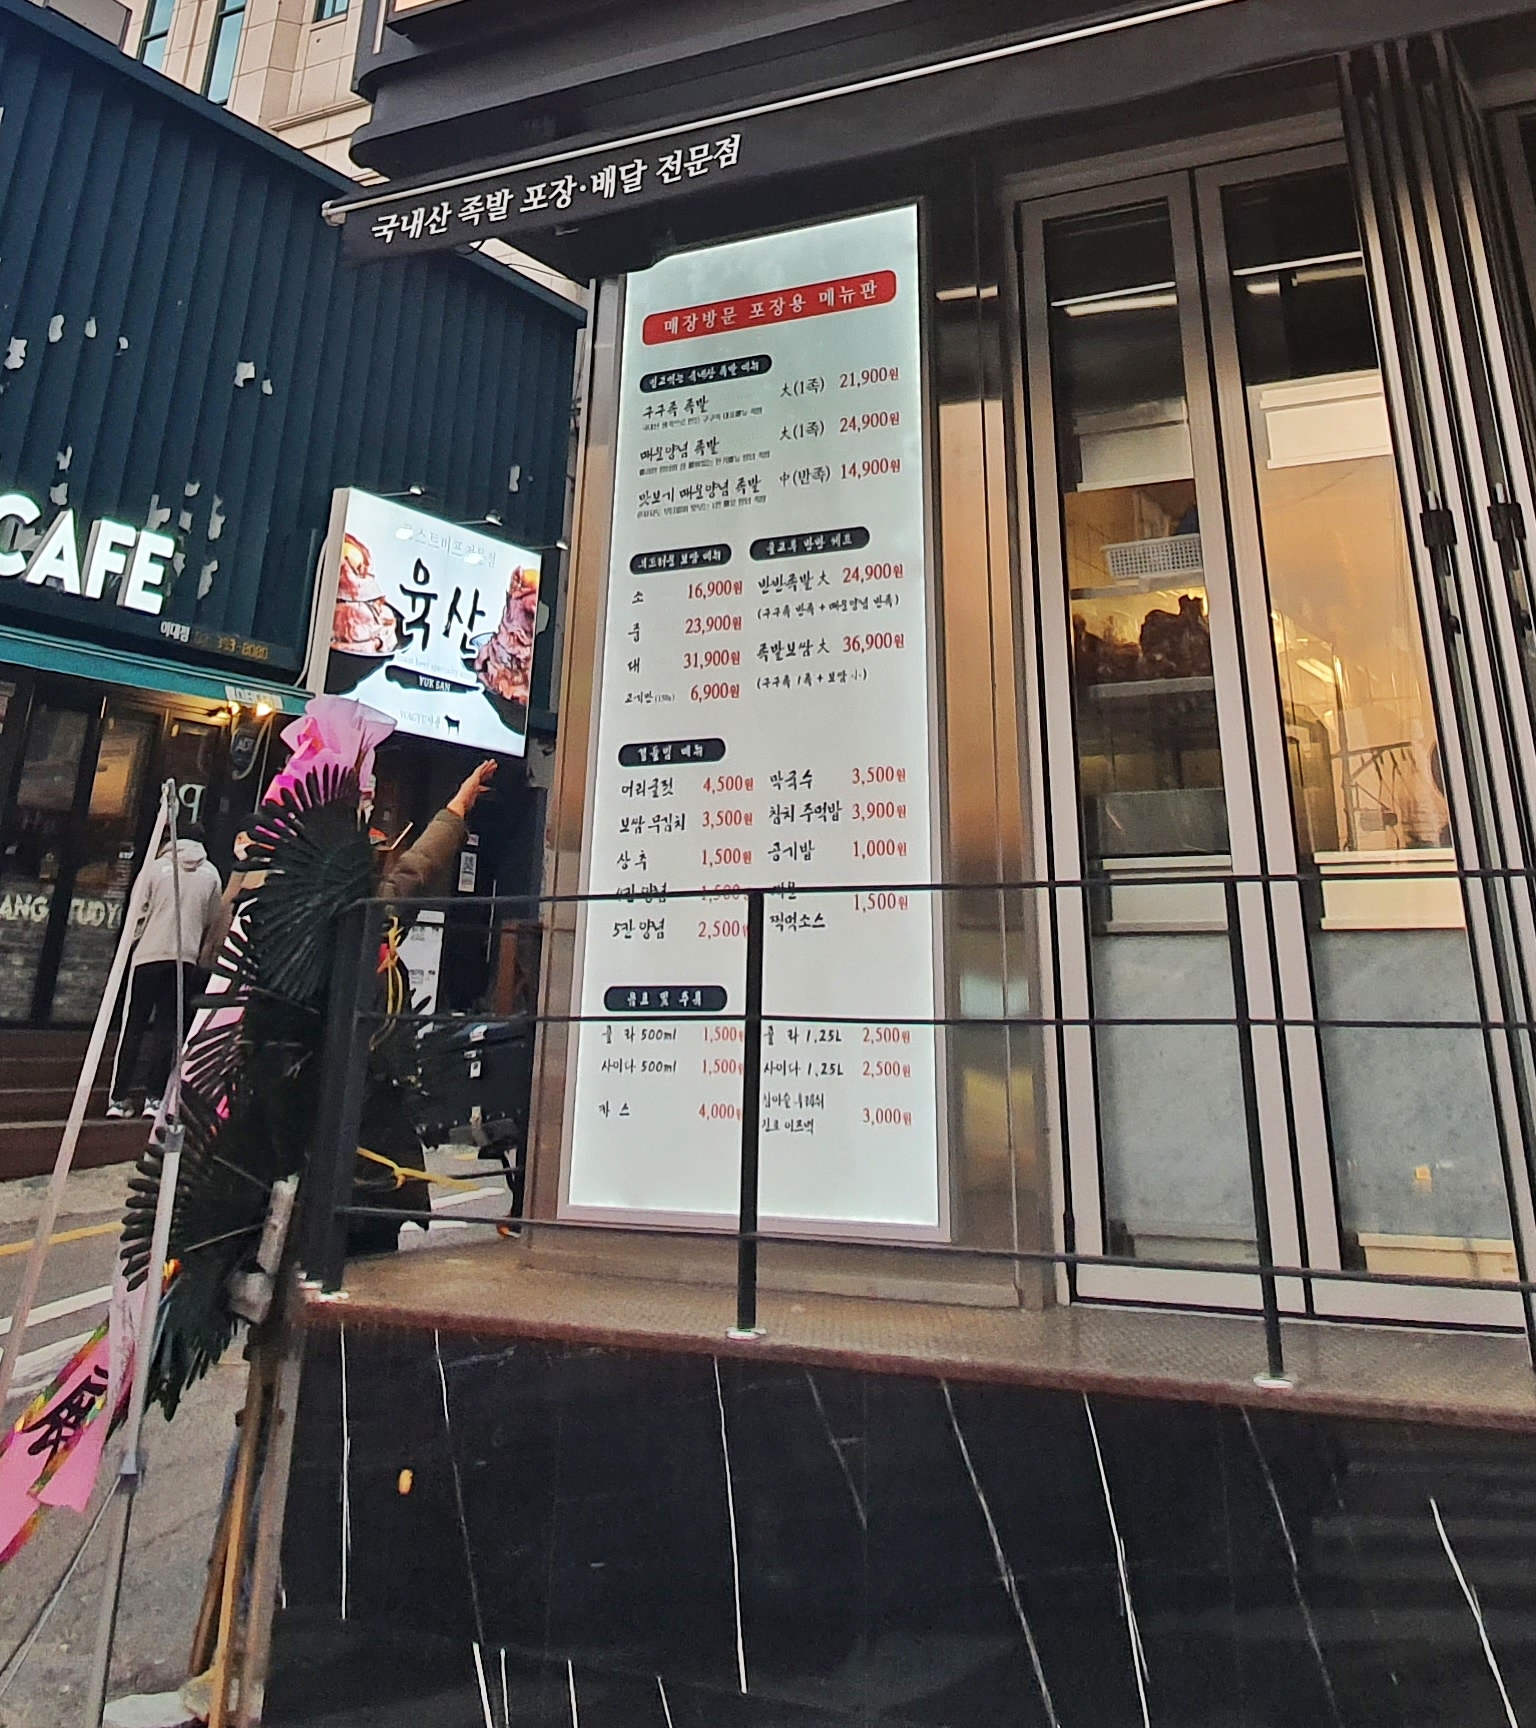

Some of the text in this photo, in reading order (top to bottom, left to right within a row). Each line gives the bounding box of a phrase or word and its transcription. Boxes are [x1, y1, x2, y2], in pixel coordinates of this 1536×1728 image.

[371, 201, 453, 244] 국내산
[457, 188, 513, 228] 족발
[655, 132, 743, 184] 전문점
[664, 279, 878, 335] 매장방문 포장용 메뉴판
[839, 367, 899, 389] 21,900원
[642, 400, 678, 419] 구구족
[684, 395, 709, 414] 족발
[839, 411, 900, 433] 24,900원
[694, 436, 720, 456] 족발
[840, 458, 901, 480] 14,900원
[639, 486, 675, 507] 맛보기
[735, 474, 762, 495] 족발
[757, 570, 814, 594] 반반족발
[842, 563, 904, 584] 24,900원
[632, 579, 743, 604] 소 16,900원
[399, 558, 486, 655] 육산
[628, 615, 742, 642] 중 23,900원
[756, 639, 814, 663] 족발보쌈
[842, 632, 904, 654] 36,900원
[628, 650, 741, 674] 대 31,900원
[419, 675, 451, 692] YUK SAN
[690, 682, 740, 703] 6,900원
[621, 775, 755, 798] 어리굴젓 4,500원
[769, 766, 906, 791] 막국수 3,500원
[619, 810, 754, 834] 보쌈 무김치 3,500원
[768, 801, 906, 826] 참치 주먹밥 3,900원
[701, 848, 752, 868] 1,500원
[768, 839, 907, 862] 공기밥 1,000원
[853, 893, 908, 912] 1,500원
[639, 918, 665, 939] 양념
[641, 1028, 677, 1042] 500ml
[806, 1029, 842, 1043] 1.25L
[863, 1027, 910, 1044] 2,500원
[602, 1059, 636, 1074] 사이다
[641, 1059, 677, 1074] 500ml
[764, 1060, 911, 1078] 사이다 1.25L 2,500원
[863, 1107, 911, 1126] 3,000원
